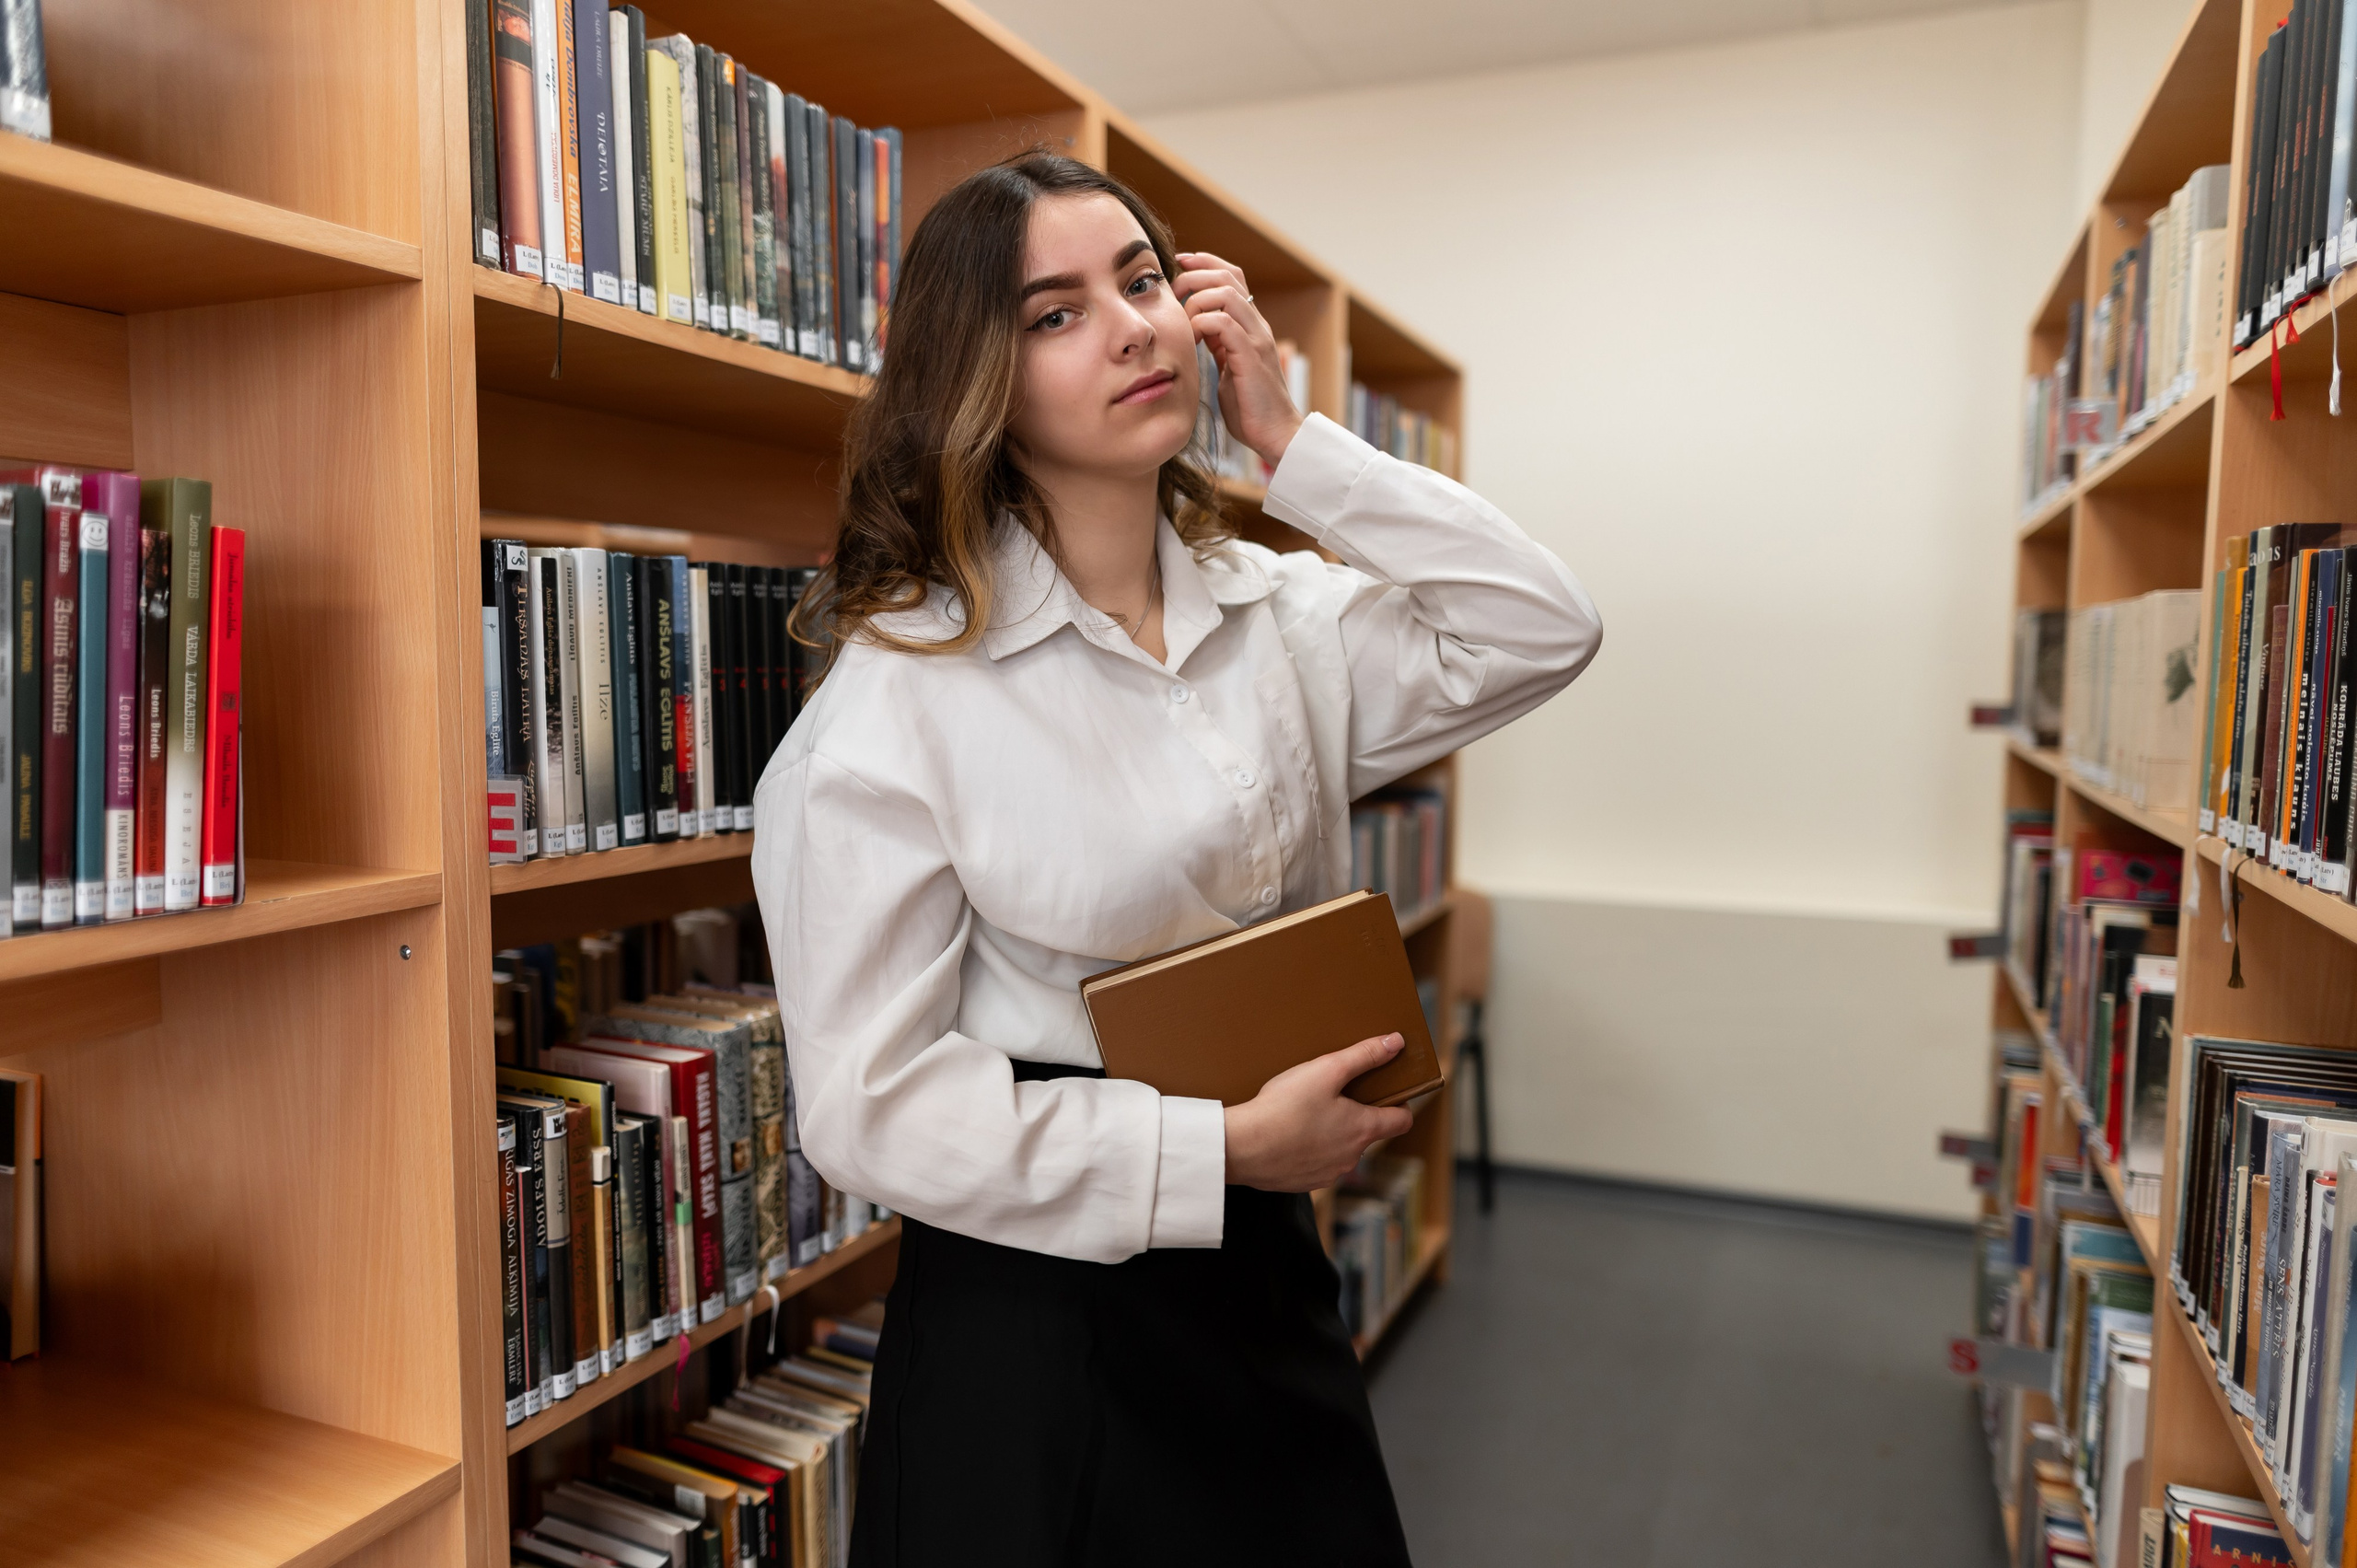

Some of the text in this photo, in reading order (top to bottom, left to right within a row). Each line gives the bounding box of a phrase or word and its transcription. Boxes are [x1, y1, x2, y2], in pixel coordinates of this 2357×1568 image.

[562, 0, 577, 158] idija Dombrovska
[2067, 410, 2102, 445] R
[188, 514, 201, 599] Leons BRIEDIS
[658, 598, 671, 680] ANŠLAVS
[183, 625, 199, 753] VĀRDA LAIKABIEDRS
[598, 683, 610, 722] Ilze
[659, 687, 673, 752] EGLĪTIS
[118, 694, 134, 796] Leons Briedis
[150, 689, 162, 759] Leons Briedis
[490, 690, 501, 757] Biruta Eglīte
[2290, 672, 2309, 830] melnais klauns
[2331, 684, 2348, 802] KONRĀDA LAUBES
[488, 792, 517, 854] E
[531, 1127, 543, 1174] ERSS
[2271, 1158, 2282, 1194] MĀRA
[2275, 1257, 2286, 1295] SENS
[1948, 1338, 1980, 1374] S
